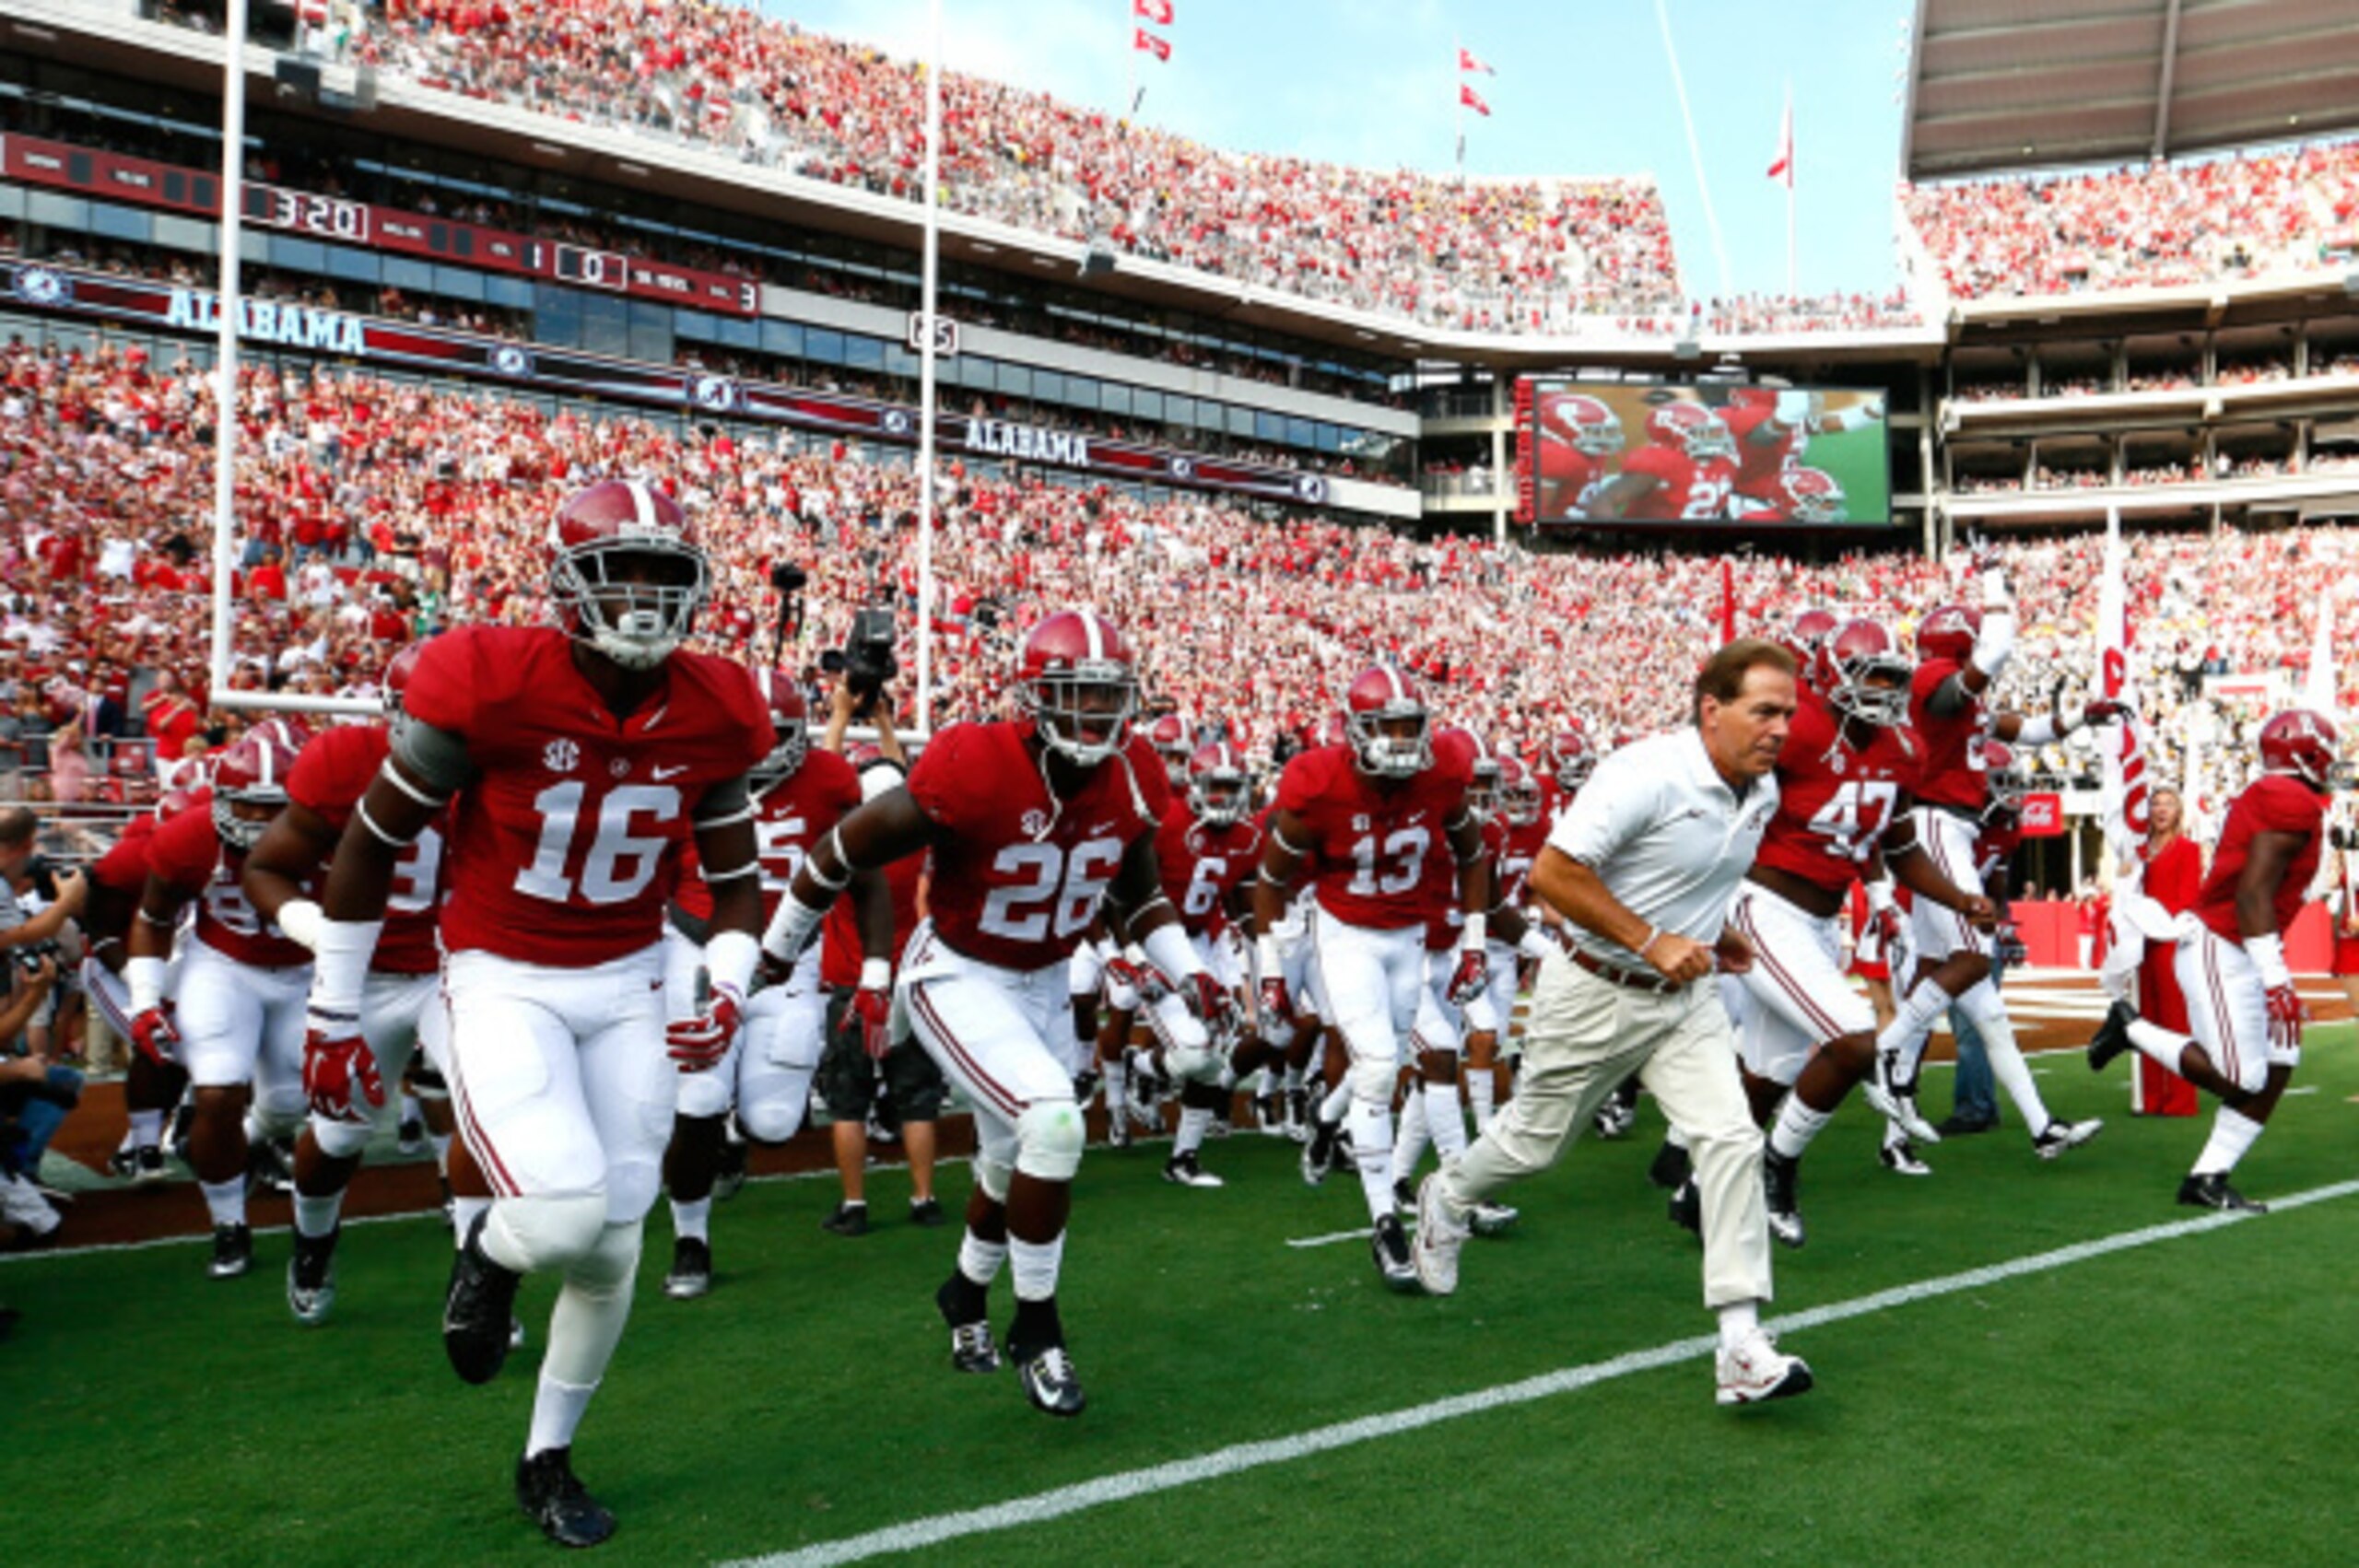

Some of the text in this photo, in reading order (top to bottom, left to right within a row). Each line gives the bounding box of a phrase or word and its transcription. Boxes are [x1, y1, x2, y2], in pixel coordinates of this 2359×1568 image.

[965, 417, 1089, 467] ALABAMA
[515, 779, 683, 904] 16
[1807, 780, 1897, 862] 47
[977, 837, 1122, 942] 26
[1182, 857, 1227, 915] 6
[1347, 826, 1430, 897] 13
